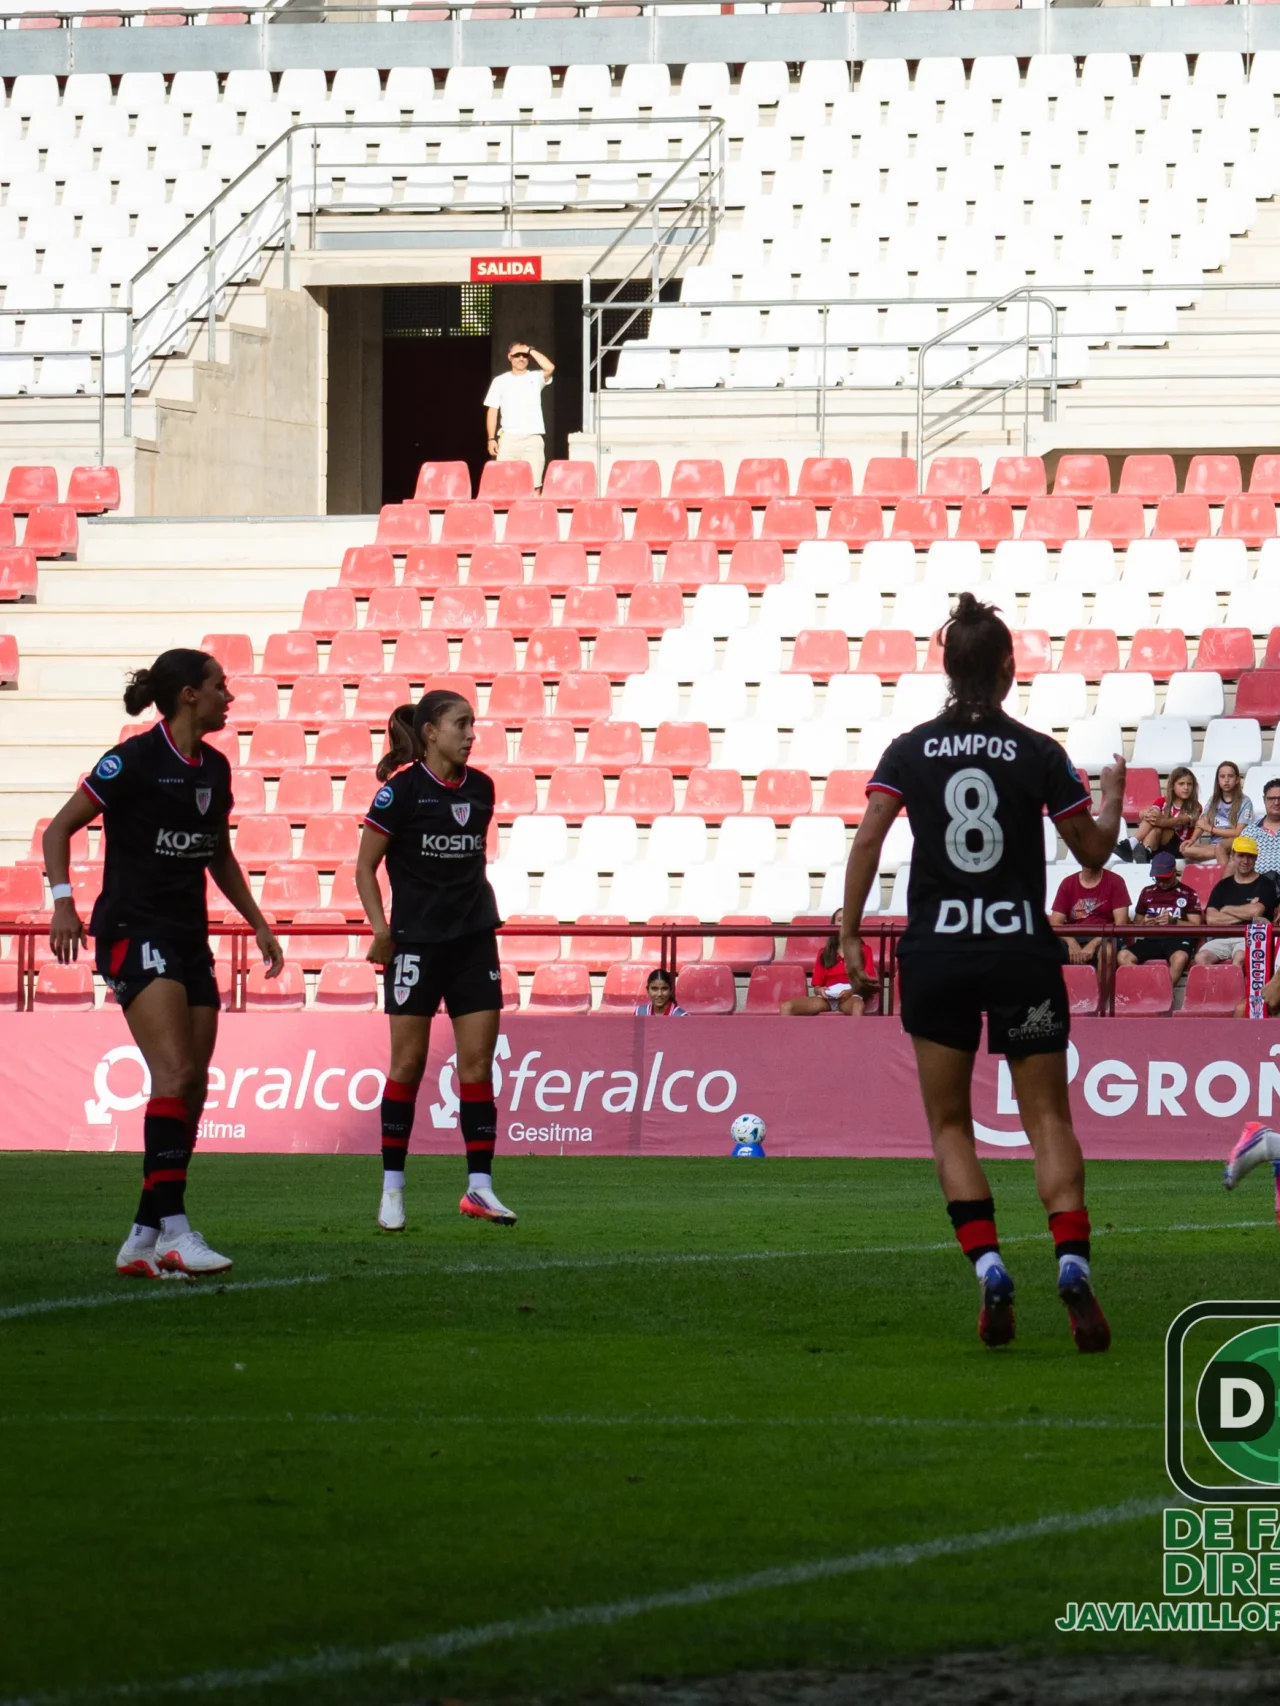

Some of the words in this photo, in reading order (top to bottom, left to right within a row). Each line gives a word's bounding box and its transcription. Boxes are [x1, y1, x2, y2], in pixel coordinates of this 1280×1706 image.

[477, 261, 535, 276] SALIDA
[923, 734, 1018, 762] CAMPOS
[944, 767, 1004, 873] 8
[934, 898, 1034, 935] DIGI
[142, 941, 166, 975] 4
[394, 953, 420, 987] 15
[1251, 948, 1266, 991] CLUB
[203, 1049, 387, 1111] eralco
[508, 1050, 738, 1113] feralco
[195, 1119, 246, 1139] sitma
[508, 1122, 593, 1142] Gesitma
